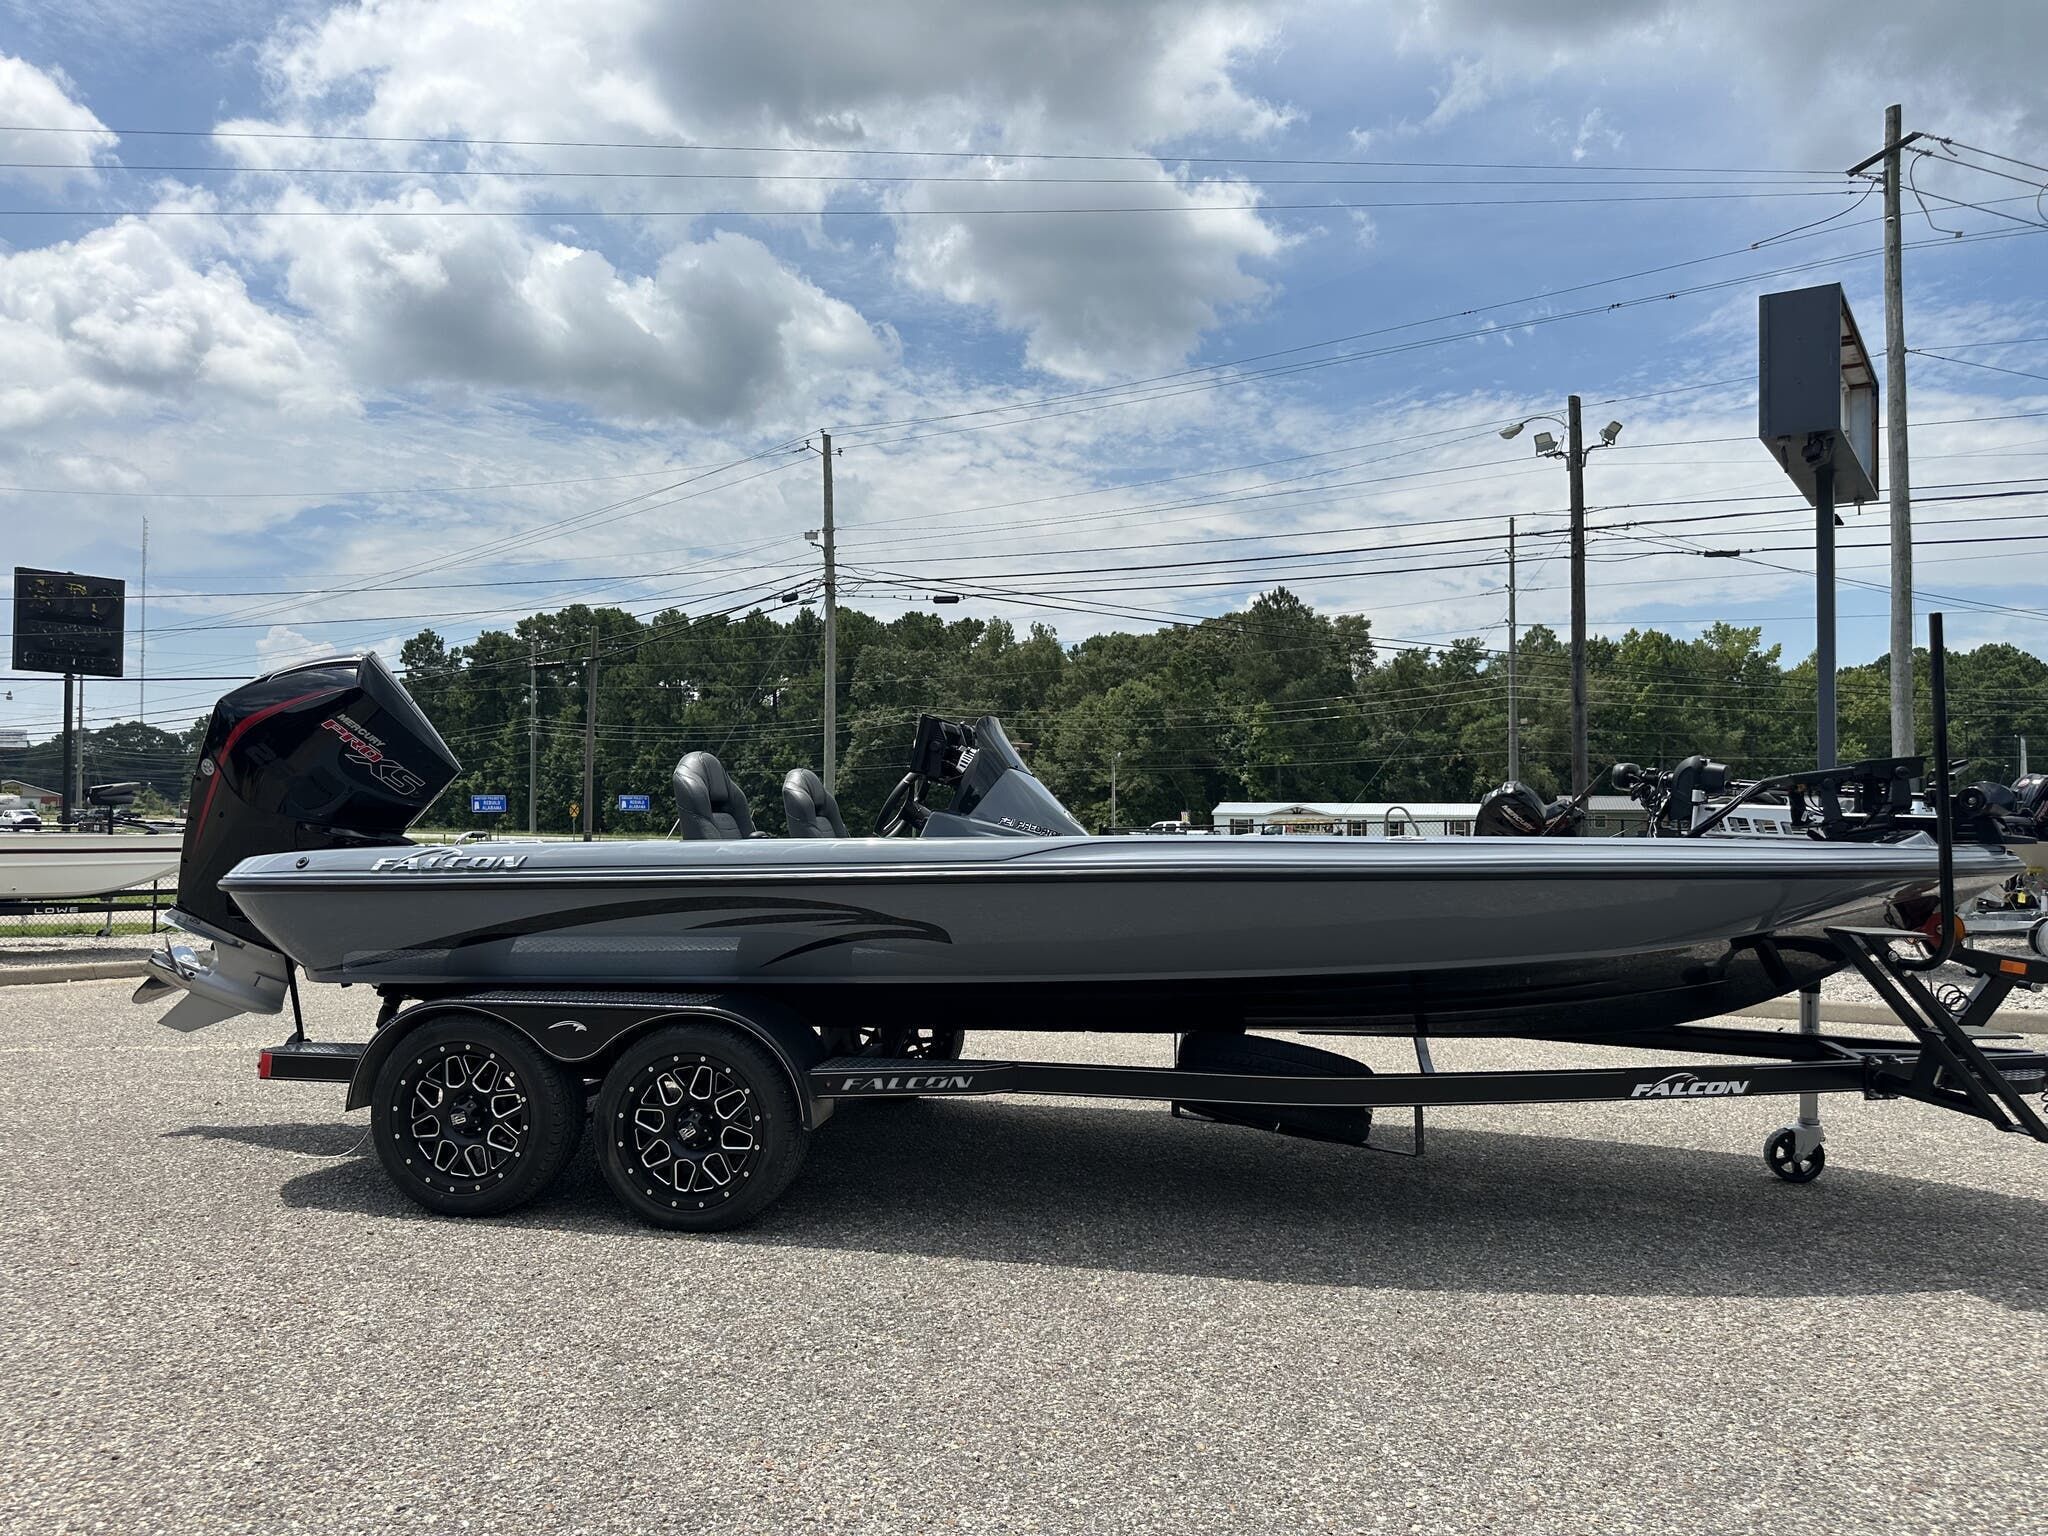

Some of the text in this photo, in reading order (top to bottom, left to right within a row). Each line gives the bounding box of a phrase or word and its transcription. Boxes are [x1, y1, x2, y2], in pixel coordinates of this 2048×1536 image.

[336, 714, 387, 747] MERCURY
[321, 719, 426, 796] PRO XS
[370, 853, 528, 871] FALCON
[33, 906, 79, 914] LOWE
[841, 1075, 974, 1091] FALCON
[1630, 1081, 1749, 1096] FALCON
